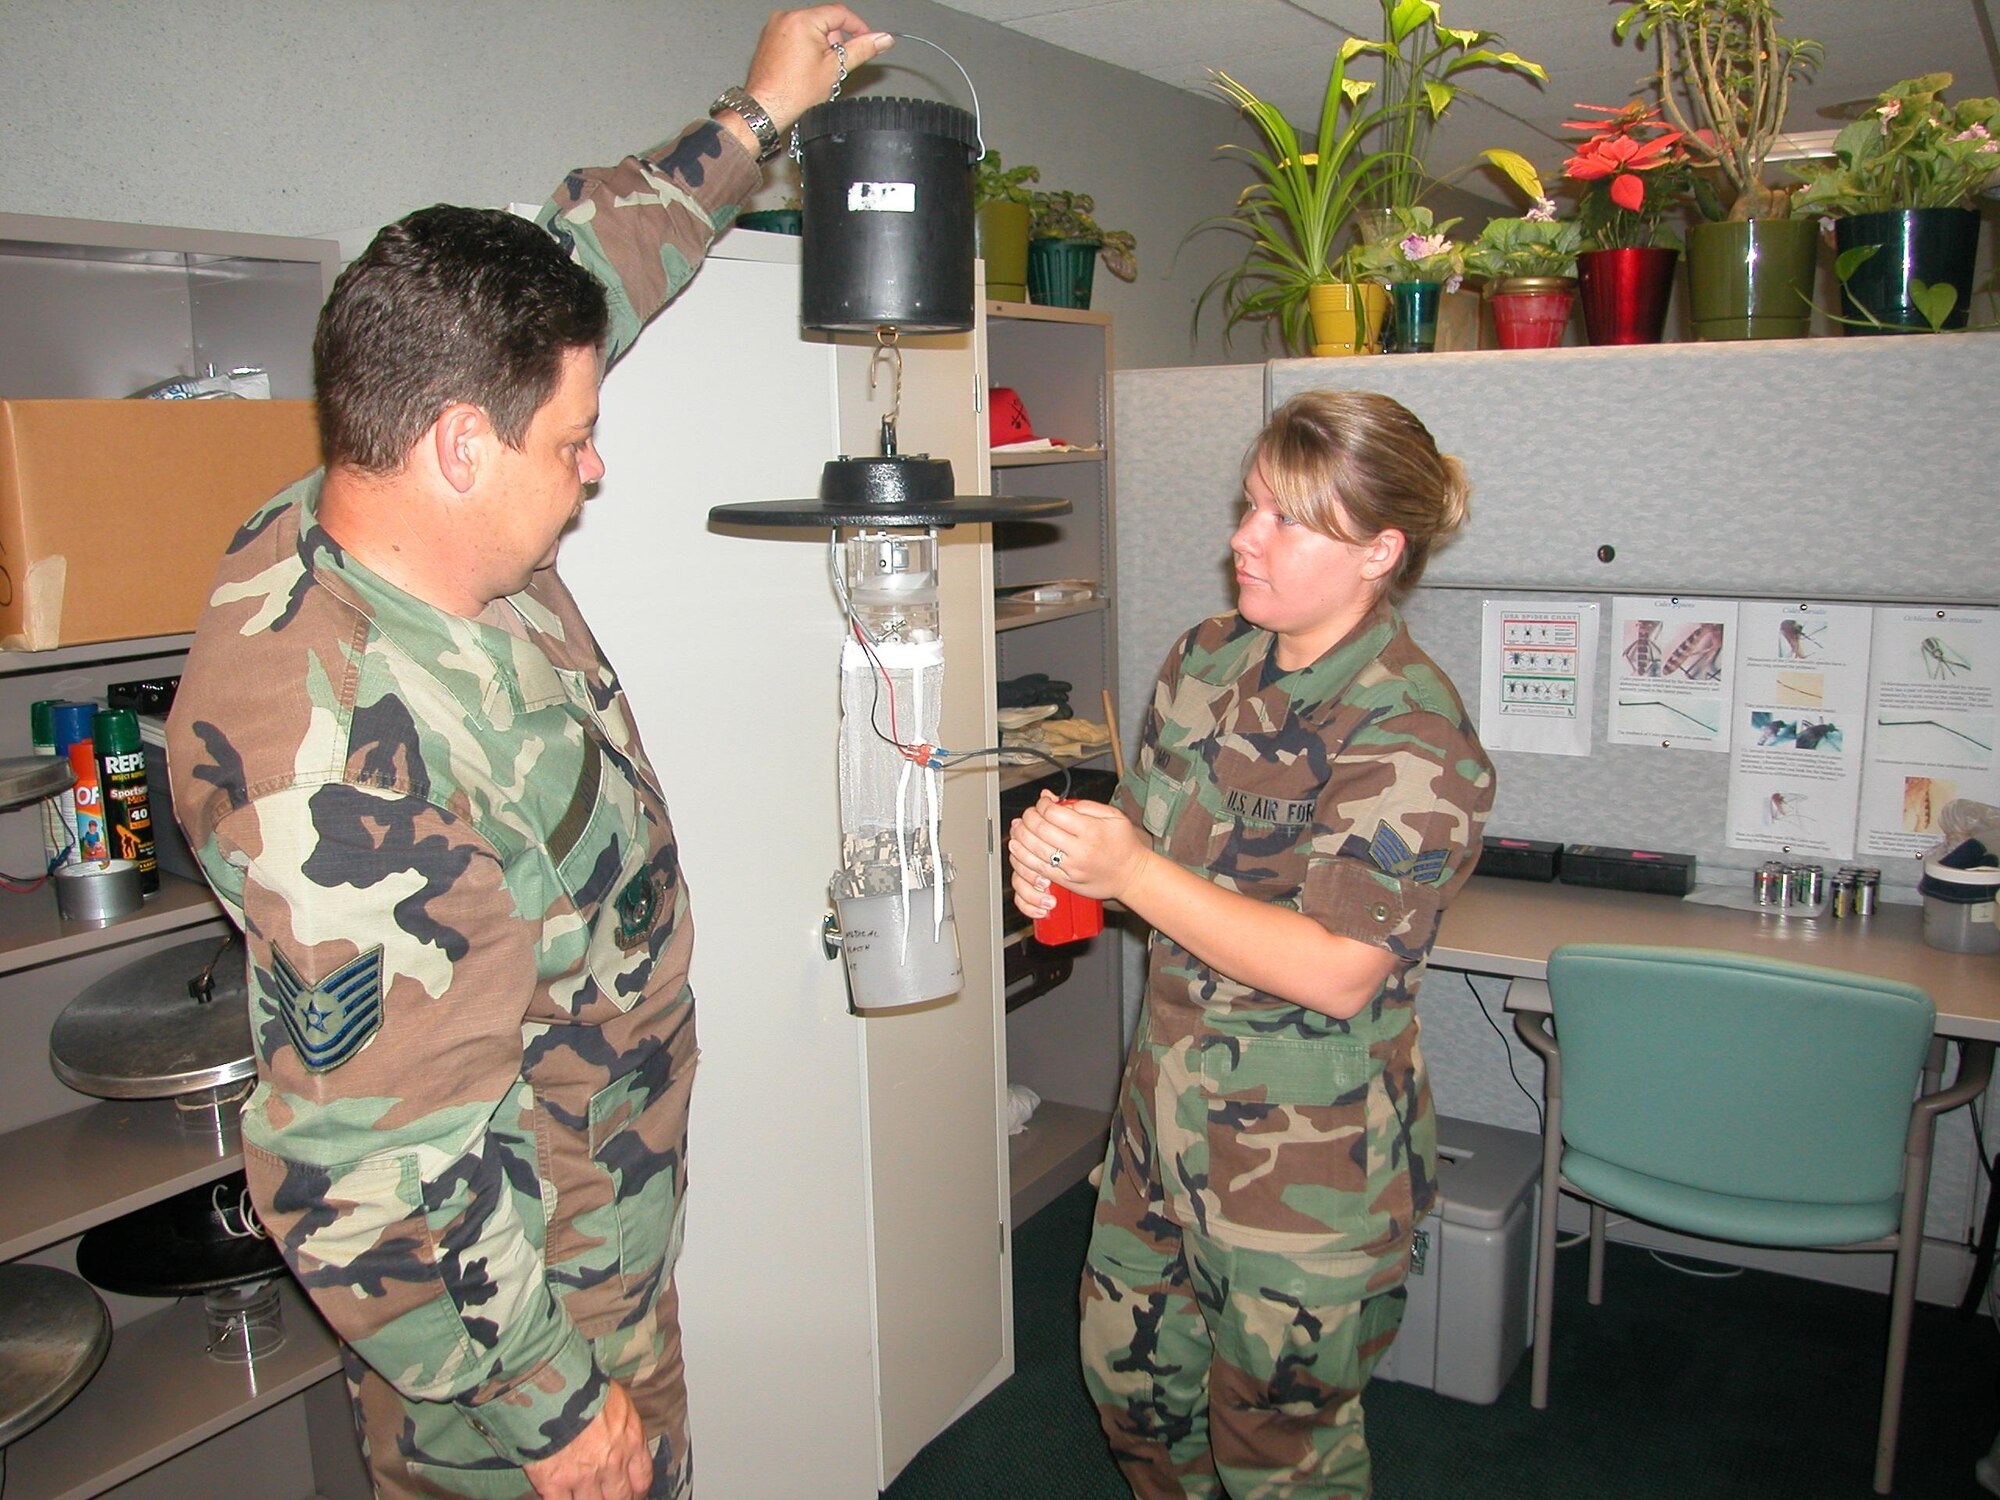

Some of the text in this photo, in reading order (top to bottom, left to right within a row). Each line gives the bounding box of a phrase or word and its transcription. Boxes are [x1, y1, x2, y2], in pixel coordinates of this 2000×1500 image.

[131, 808, 148, 821] 40
[1226, 791, 1246, 814] U.S.
[1251, 797, 1278, 821] AIR
